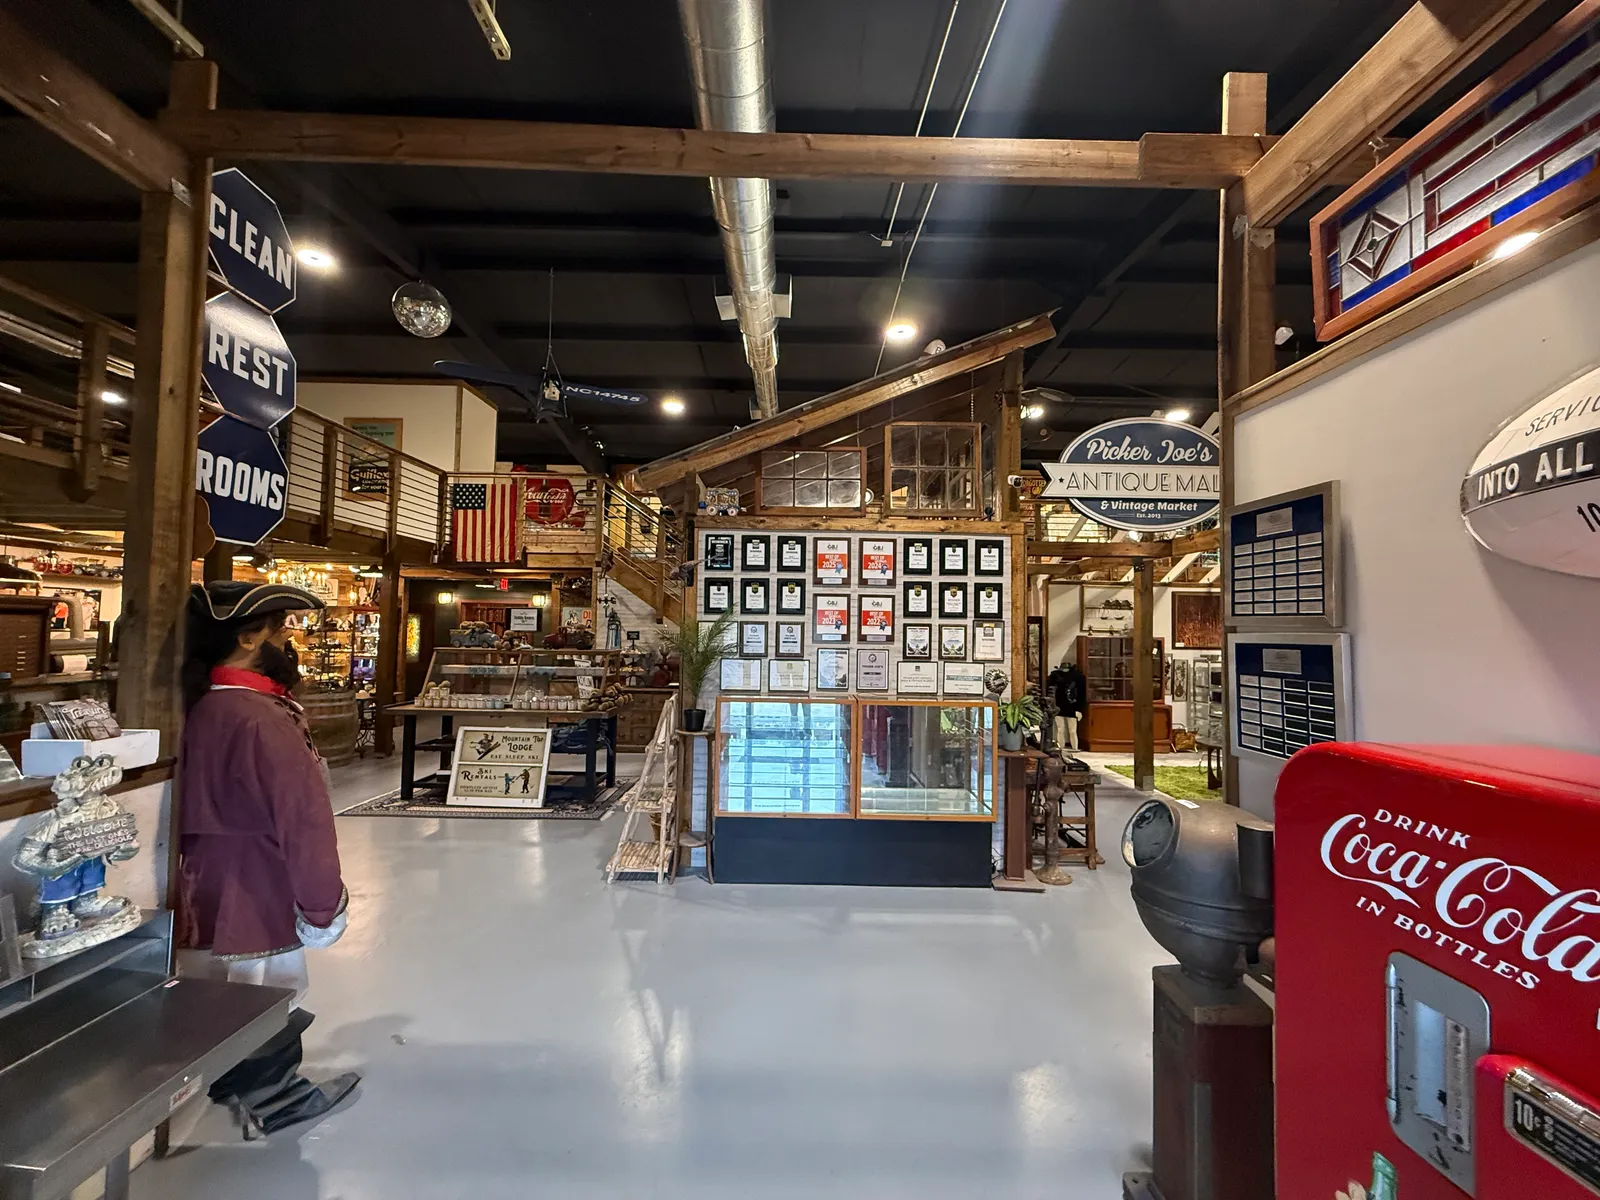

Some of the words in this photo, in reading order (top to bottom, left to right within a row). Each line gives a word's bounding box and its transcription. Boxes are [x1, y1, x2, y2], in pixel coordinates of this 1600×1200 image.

[209, 193, 292, 290] CLEAN
[208, 322, 289, 396] REST
[1086, 435, 1152, 462] Picker
[1157, 438, 1213, 463] Joe's
[1477, 463, 1520, 501] INTO
[1535, 442, 1594, 483] ALL
[196, 448, 285, 511] ROOMS
[1066, 472, 1170, 492] ANTIQUE
[1100, 500, 1108, 510] &
[1111, 500, 1155, 513] Vintage
[1157, 501, 1198, 511] Market
[508, 743, 533, 753] LODGE
[64, 819, 128, 841] WELCOME
[1374, 809, 1471, 849] DRINK
[1320, 813, 1600, 982] Coca-Cola
[1356, 896, 1386, 917] IN
[1393, 913, 1540, 989] BOTTLES
